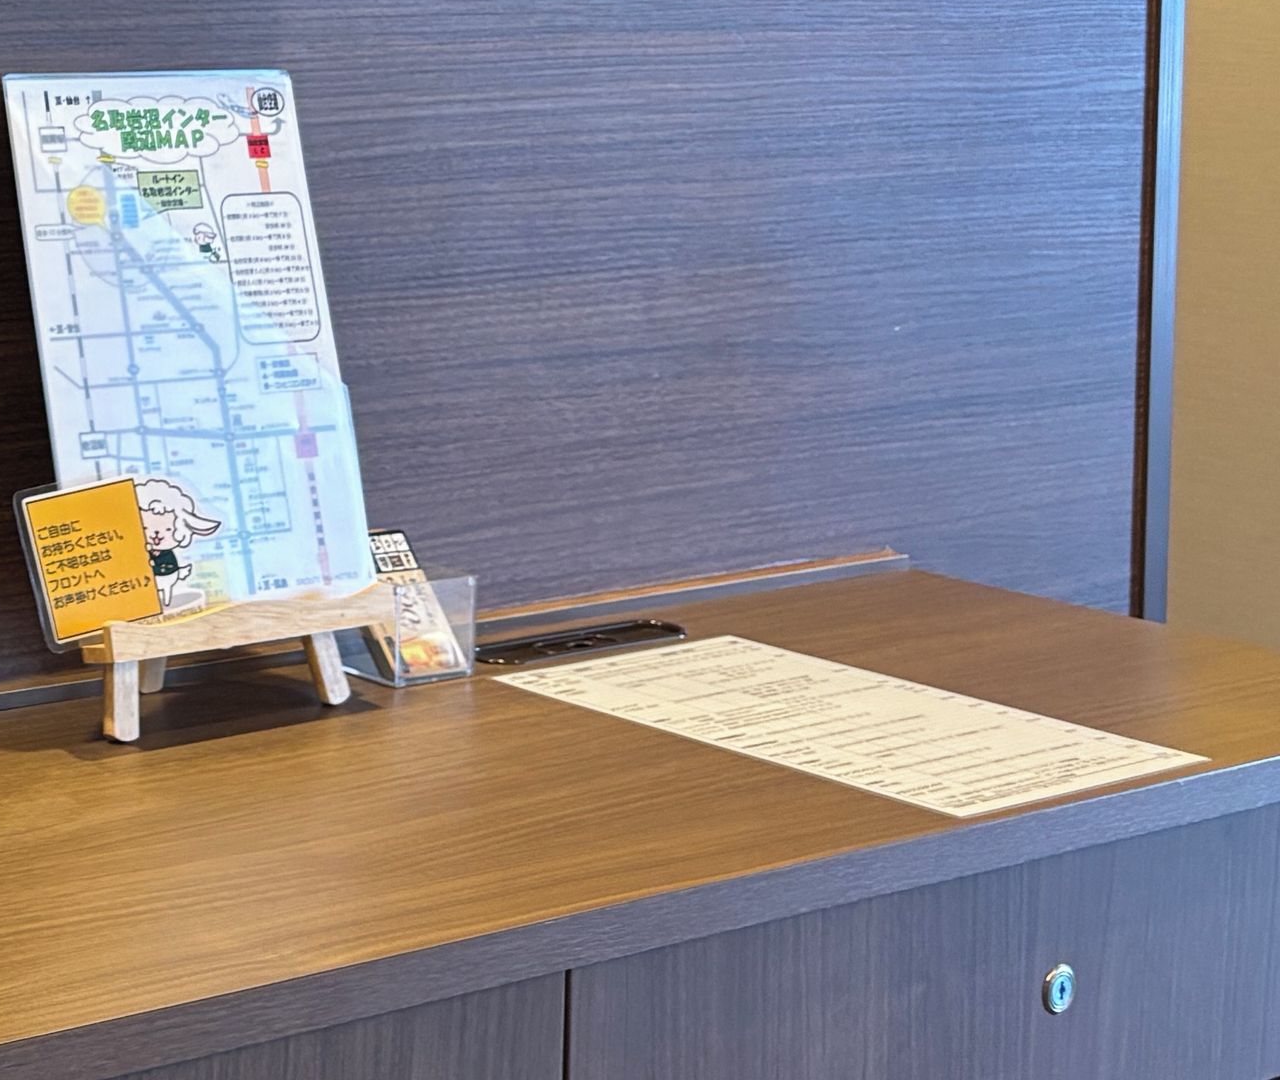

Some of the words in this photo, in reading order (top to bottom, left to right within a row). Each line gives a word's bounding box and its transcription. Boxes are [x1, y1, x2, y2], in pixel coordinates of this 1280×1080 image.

[90, 108, 227, 131] 名取岩沼インター
[121, 129, 204, 152] 周辺MAP
[37, 520, 82, 540] ご自由に
[42, 529, 124, 557] お持ちください。
[45, 549, 112, 575] ご不明な点は
[49, 569, 105, 593] フロントへ
